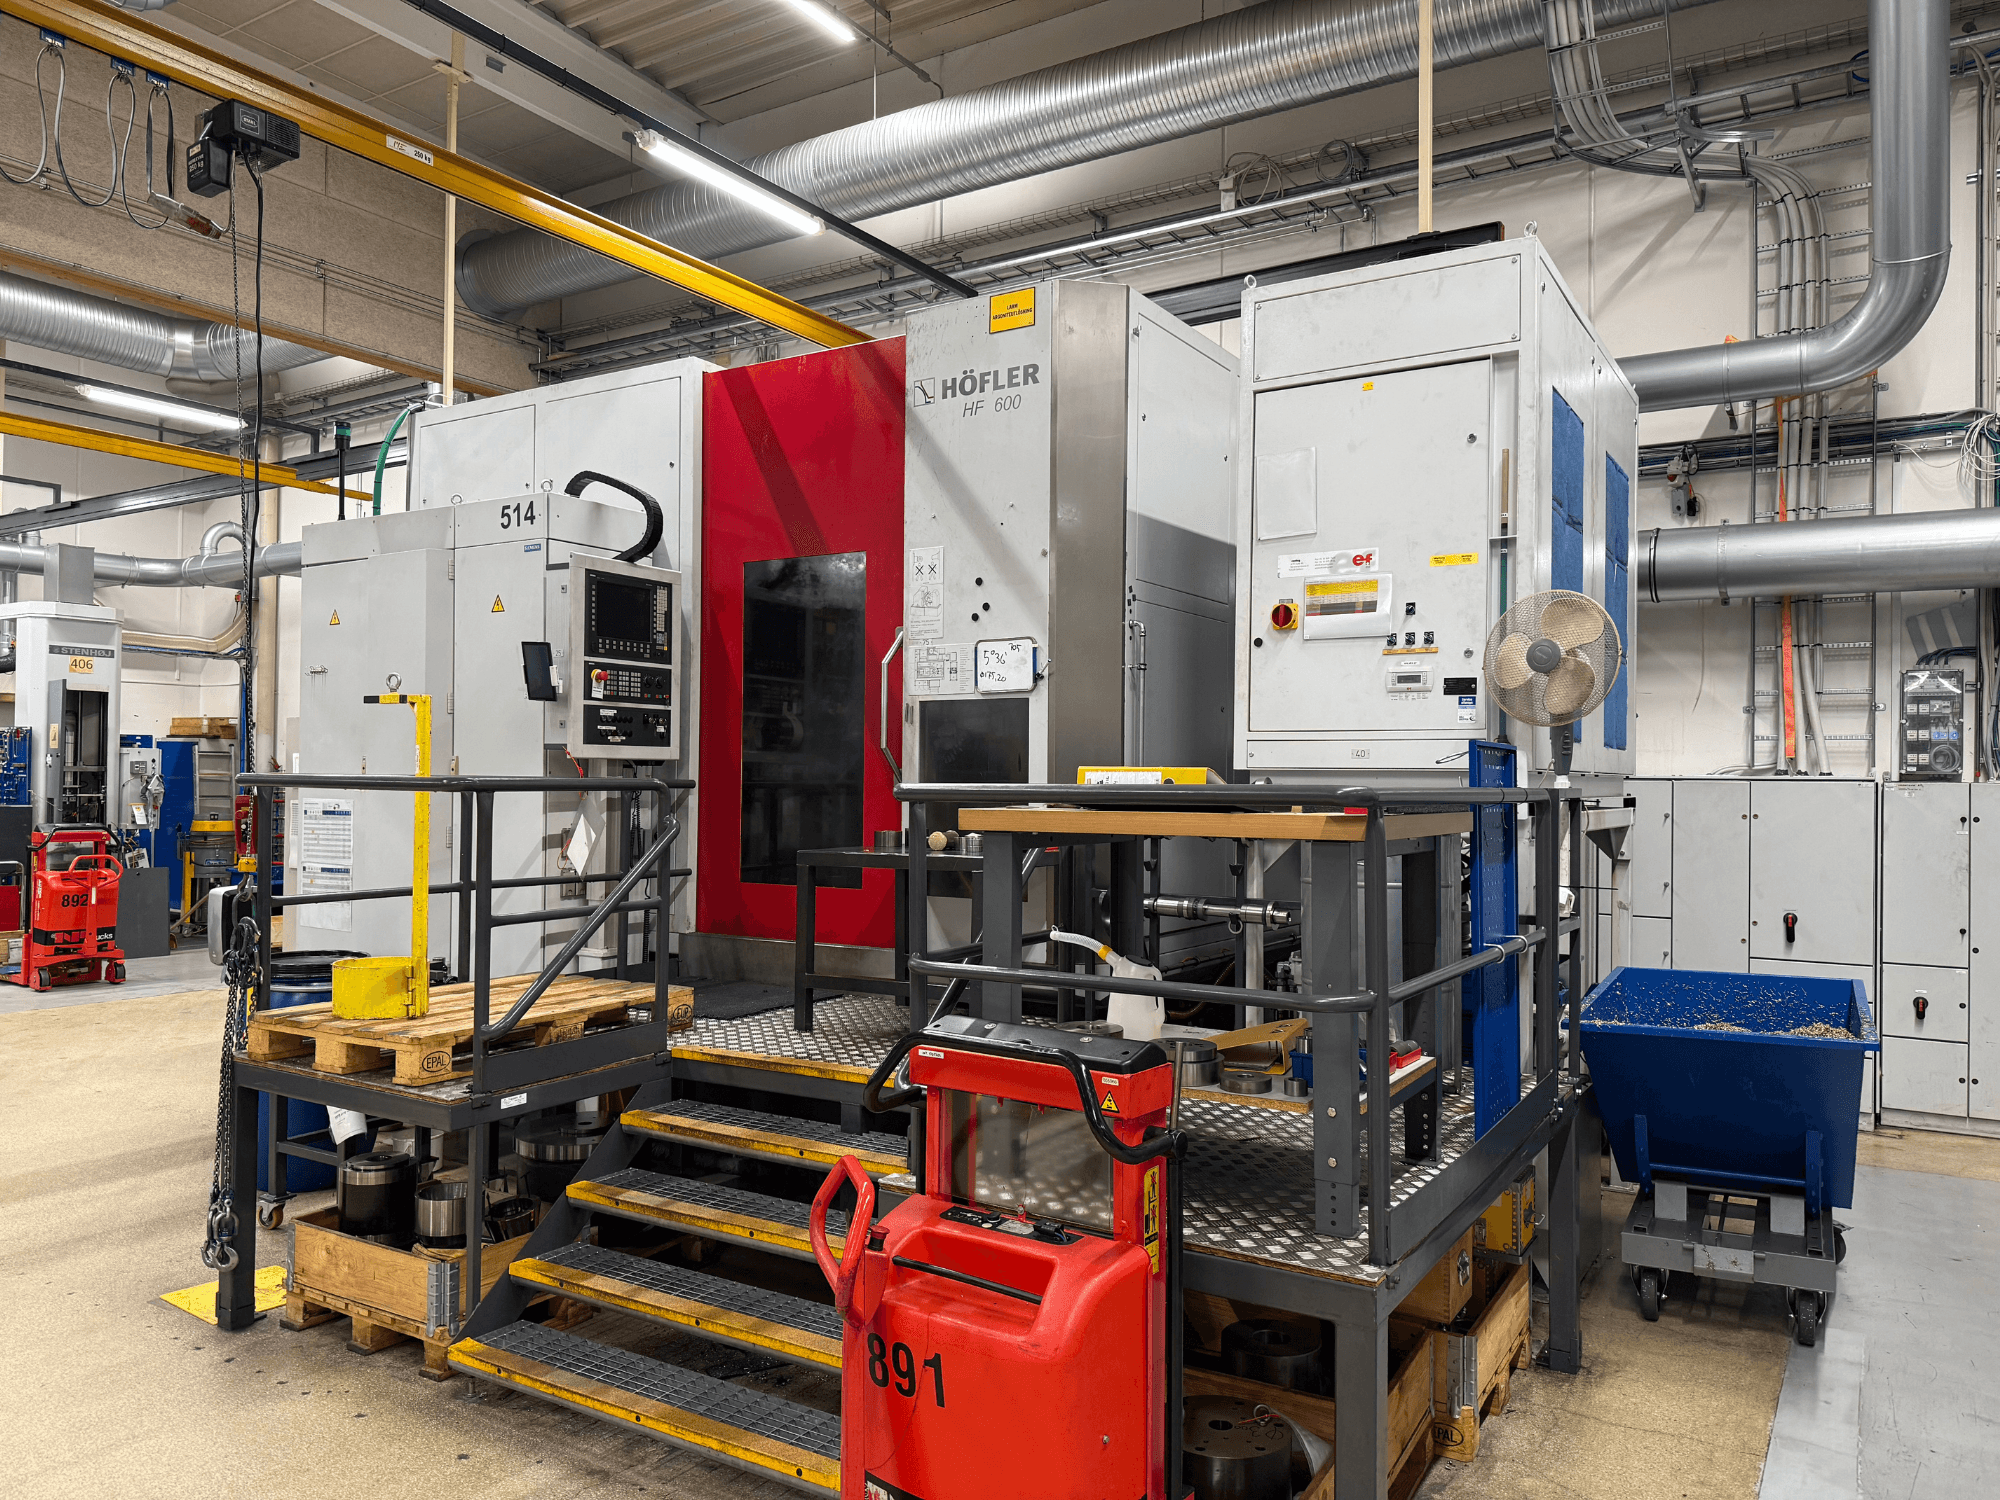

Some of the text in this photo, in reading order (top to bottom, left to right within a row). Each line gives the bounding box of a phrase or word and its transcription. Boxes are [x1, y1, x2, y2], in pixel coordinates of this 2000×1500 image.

[413, 149, 424, 160] 250
[942, 364, 1040, 399] HÖFLER
[962, 394, 1022, 418] HF 600
[500, 500, 536, 529] 514
[61, 647, 112, 657] STENHØJ
[70, 658, 93, 670] 406
[1355, 749, 1366, 758] 40
[61, 893, 89, 908] 892
[426, 1054, 447, 1069] EPAL
[867, 1332, 946, 1409] 891
[1434, 1427, 1458, 1444] PAL
